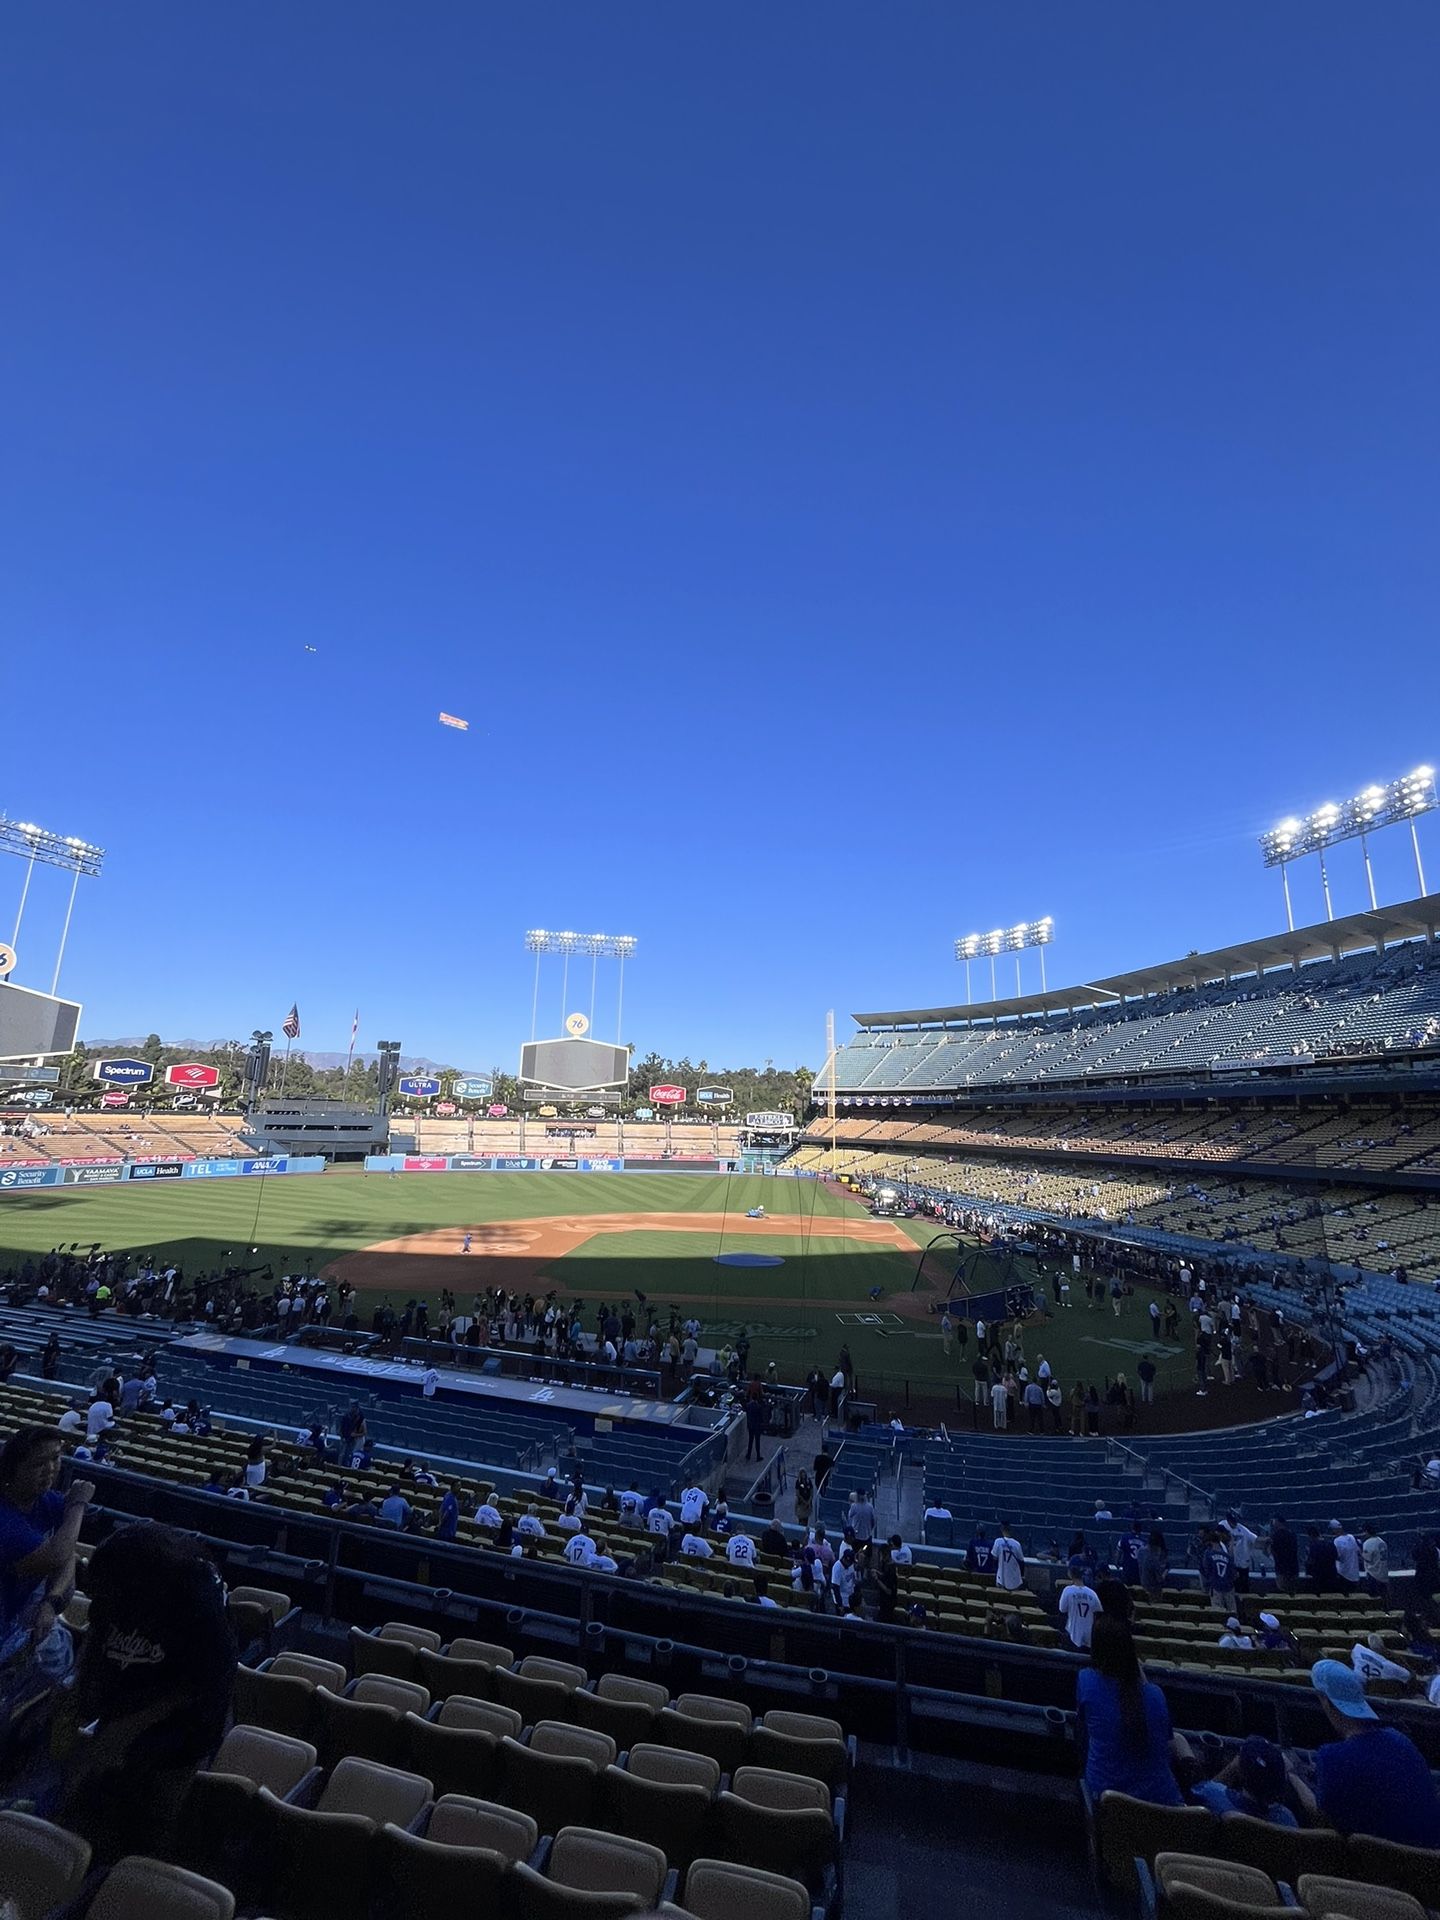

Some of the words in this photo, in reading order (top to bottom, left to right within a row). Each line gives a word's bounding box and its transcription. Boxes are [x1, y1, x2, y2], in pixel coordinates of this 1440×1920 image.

[572, 1019, 583, 1029] 76
[104, 1065, 145, 1076] Spectrum
[408, 1081, 432, 1089] ULTRA
[652, 1089, 682, 1100] Coca-Cola
[136, 1168, 153, 1176] UCLA
[156, 1165, 179, 1175] Health
[189, 1163, 212, 1175] TEL
[251, 1161, 271, 1170] ANA
[18, 1170, 47, 1179] Security
[17, 1177, 42, 1185] Benefit
[655, 1520, 661, 1531] 5
[573, 1548, 583, 1562] 17
[734, 1545, 749, 1559] 22
[1003, 1550, 1013, 1564] 17
[977, 1553, 989, 1567] 17
[1078, 1602, 1090, 1618] 17
